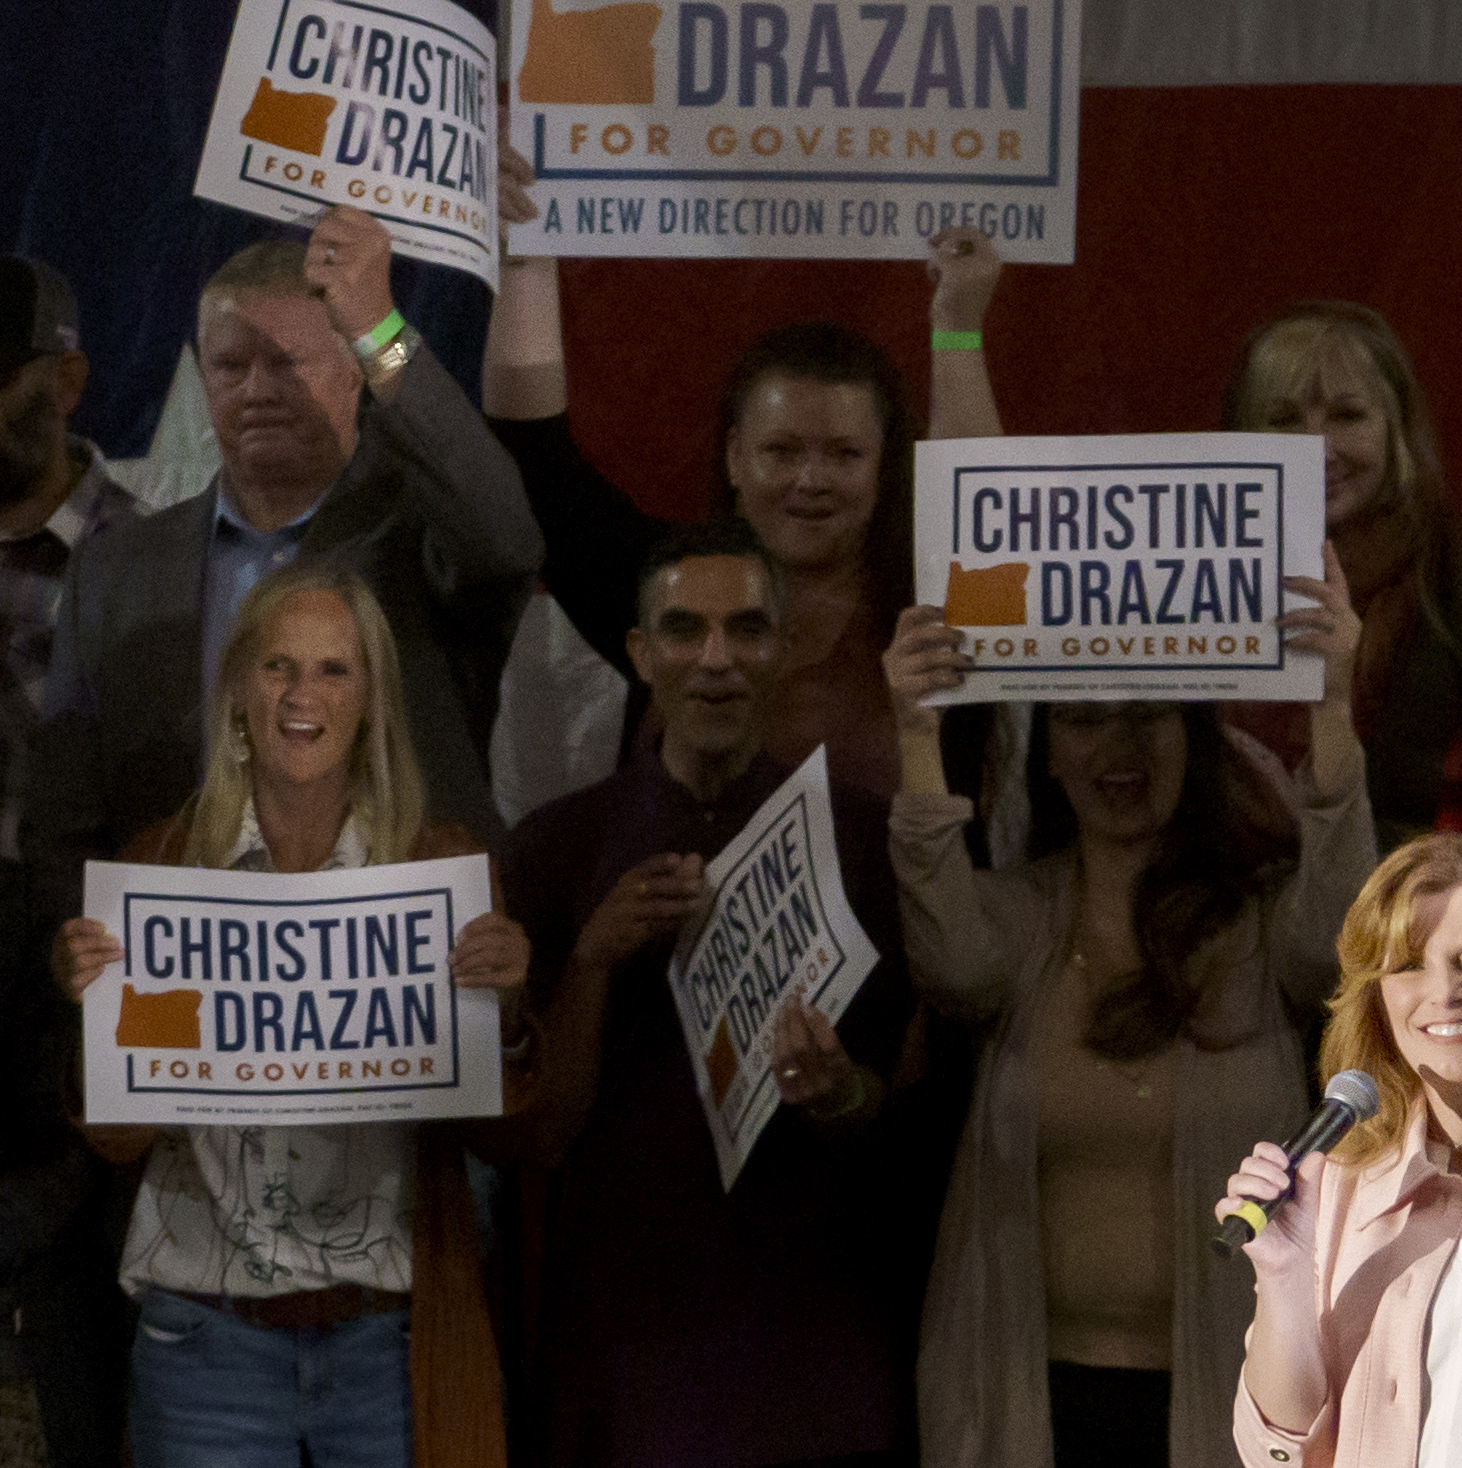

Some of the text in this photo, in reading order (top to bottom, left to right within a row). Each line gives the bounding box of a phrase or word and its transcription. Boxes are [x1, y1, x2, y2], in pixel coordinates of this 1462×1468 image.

[288, 14, 486, 132] CHRISTINE
[676, 1, 1028, 110] DRAZAN
[263, 155, 327, 189] FOR
[569, 123, 1021, 162] FOR GOVERNOR
[543, 197, 1045, 240] A NEW DIRECTION FOR OREGON
[972, 482, 1264, 553] CHRISTINE
[1041, 558, 1263, 627] DRAZAN
[974, 634, 1260, 658] FOR GOVERNOR
[143, 909, 436, 983] CHRISTINE
[689, 817, 803, 1032] CHRISTINE
[726, 880, 819, 1058] DRAZAN
[214, 982, 437, 1053] DRAZAN
[150, 1057, 435, 1082] FOR GOVERNOR
